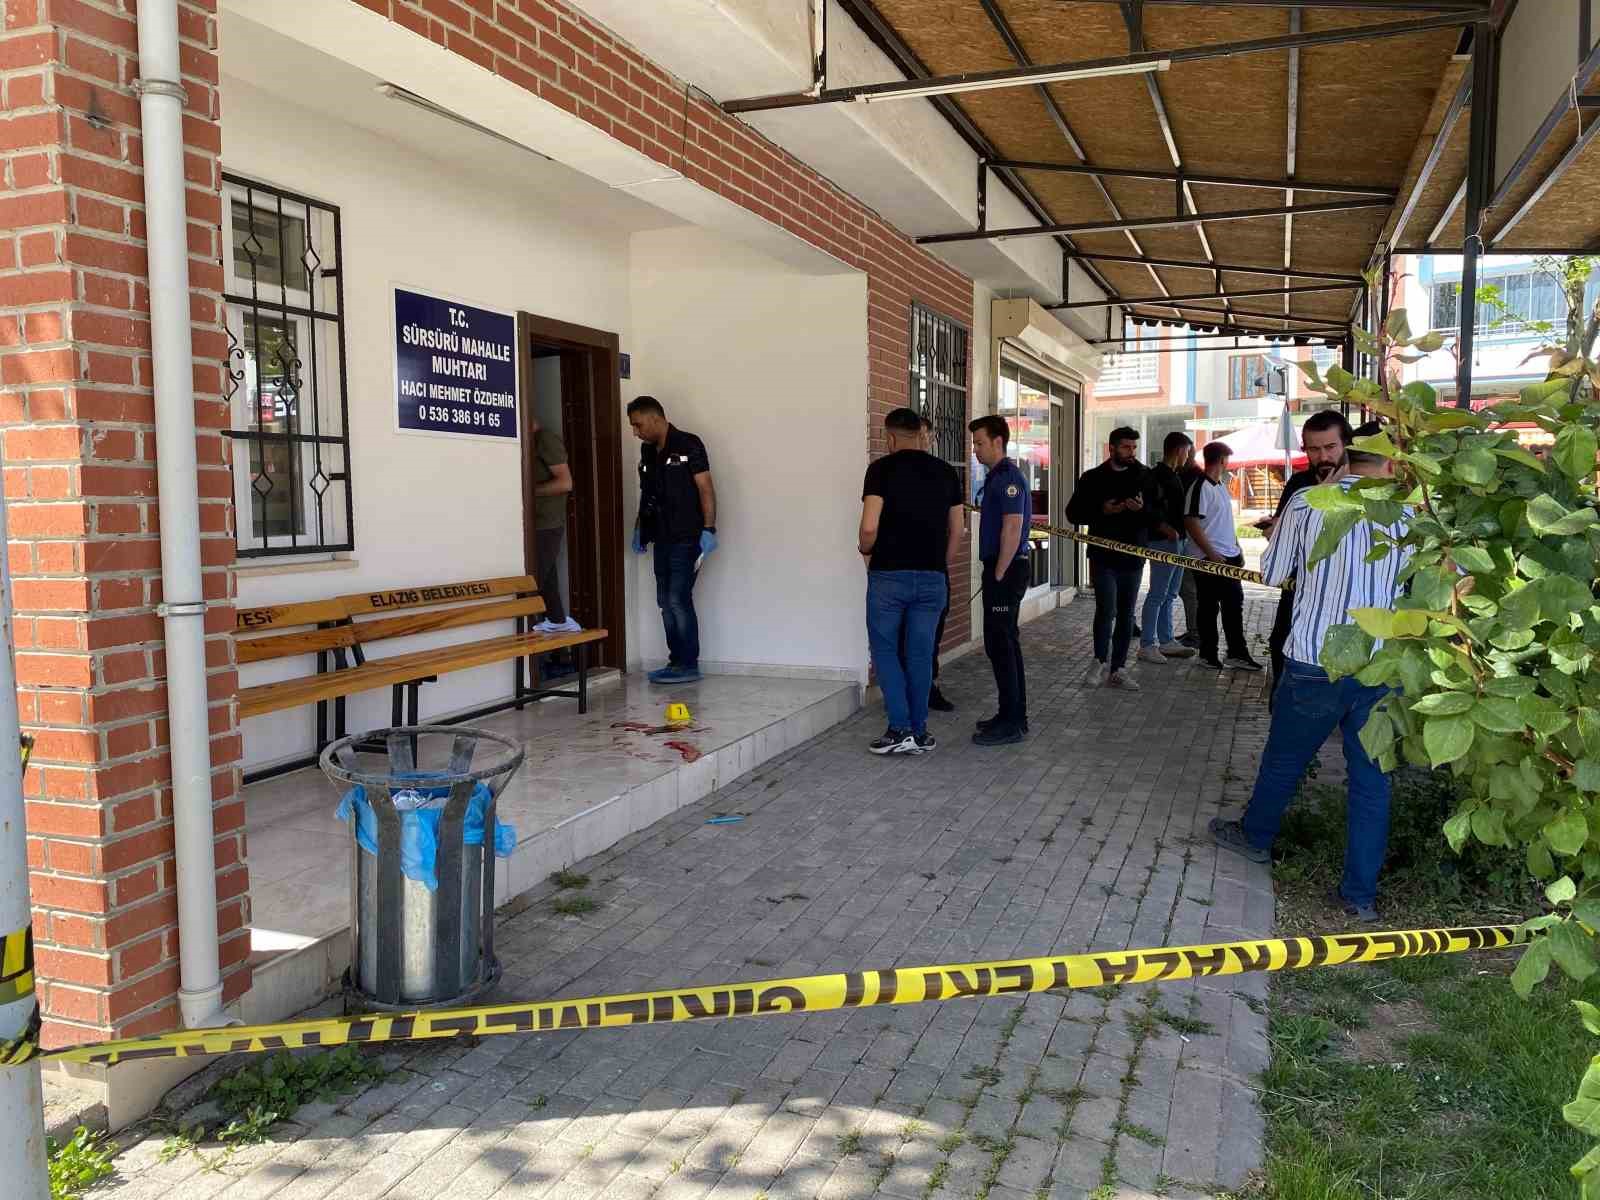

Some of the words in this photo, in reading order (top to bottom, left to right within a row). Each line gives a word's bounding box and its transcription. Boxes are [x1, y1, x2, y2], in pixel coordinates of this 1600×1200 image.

[448, 307, 469, 328] T.C.
[402, 323, 459, 353] SÜRSÜRÜ
[461, 337, 511, 362] MAHALLE
[432, 355, 488, 381] MUHTARI
[401, 379, 427, 398] HACI
[429, 383, 472, 403] MEHMET
[473, 387, 515, 409] ÖZDEMİR
[418, 404, 427, 421] 0
[429, 406, 449, 422] 536
[451, 408, 471, 425] 386
[473, 411, 485, 427] 91
[488, 413, 501, 428] 65
